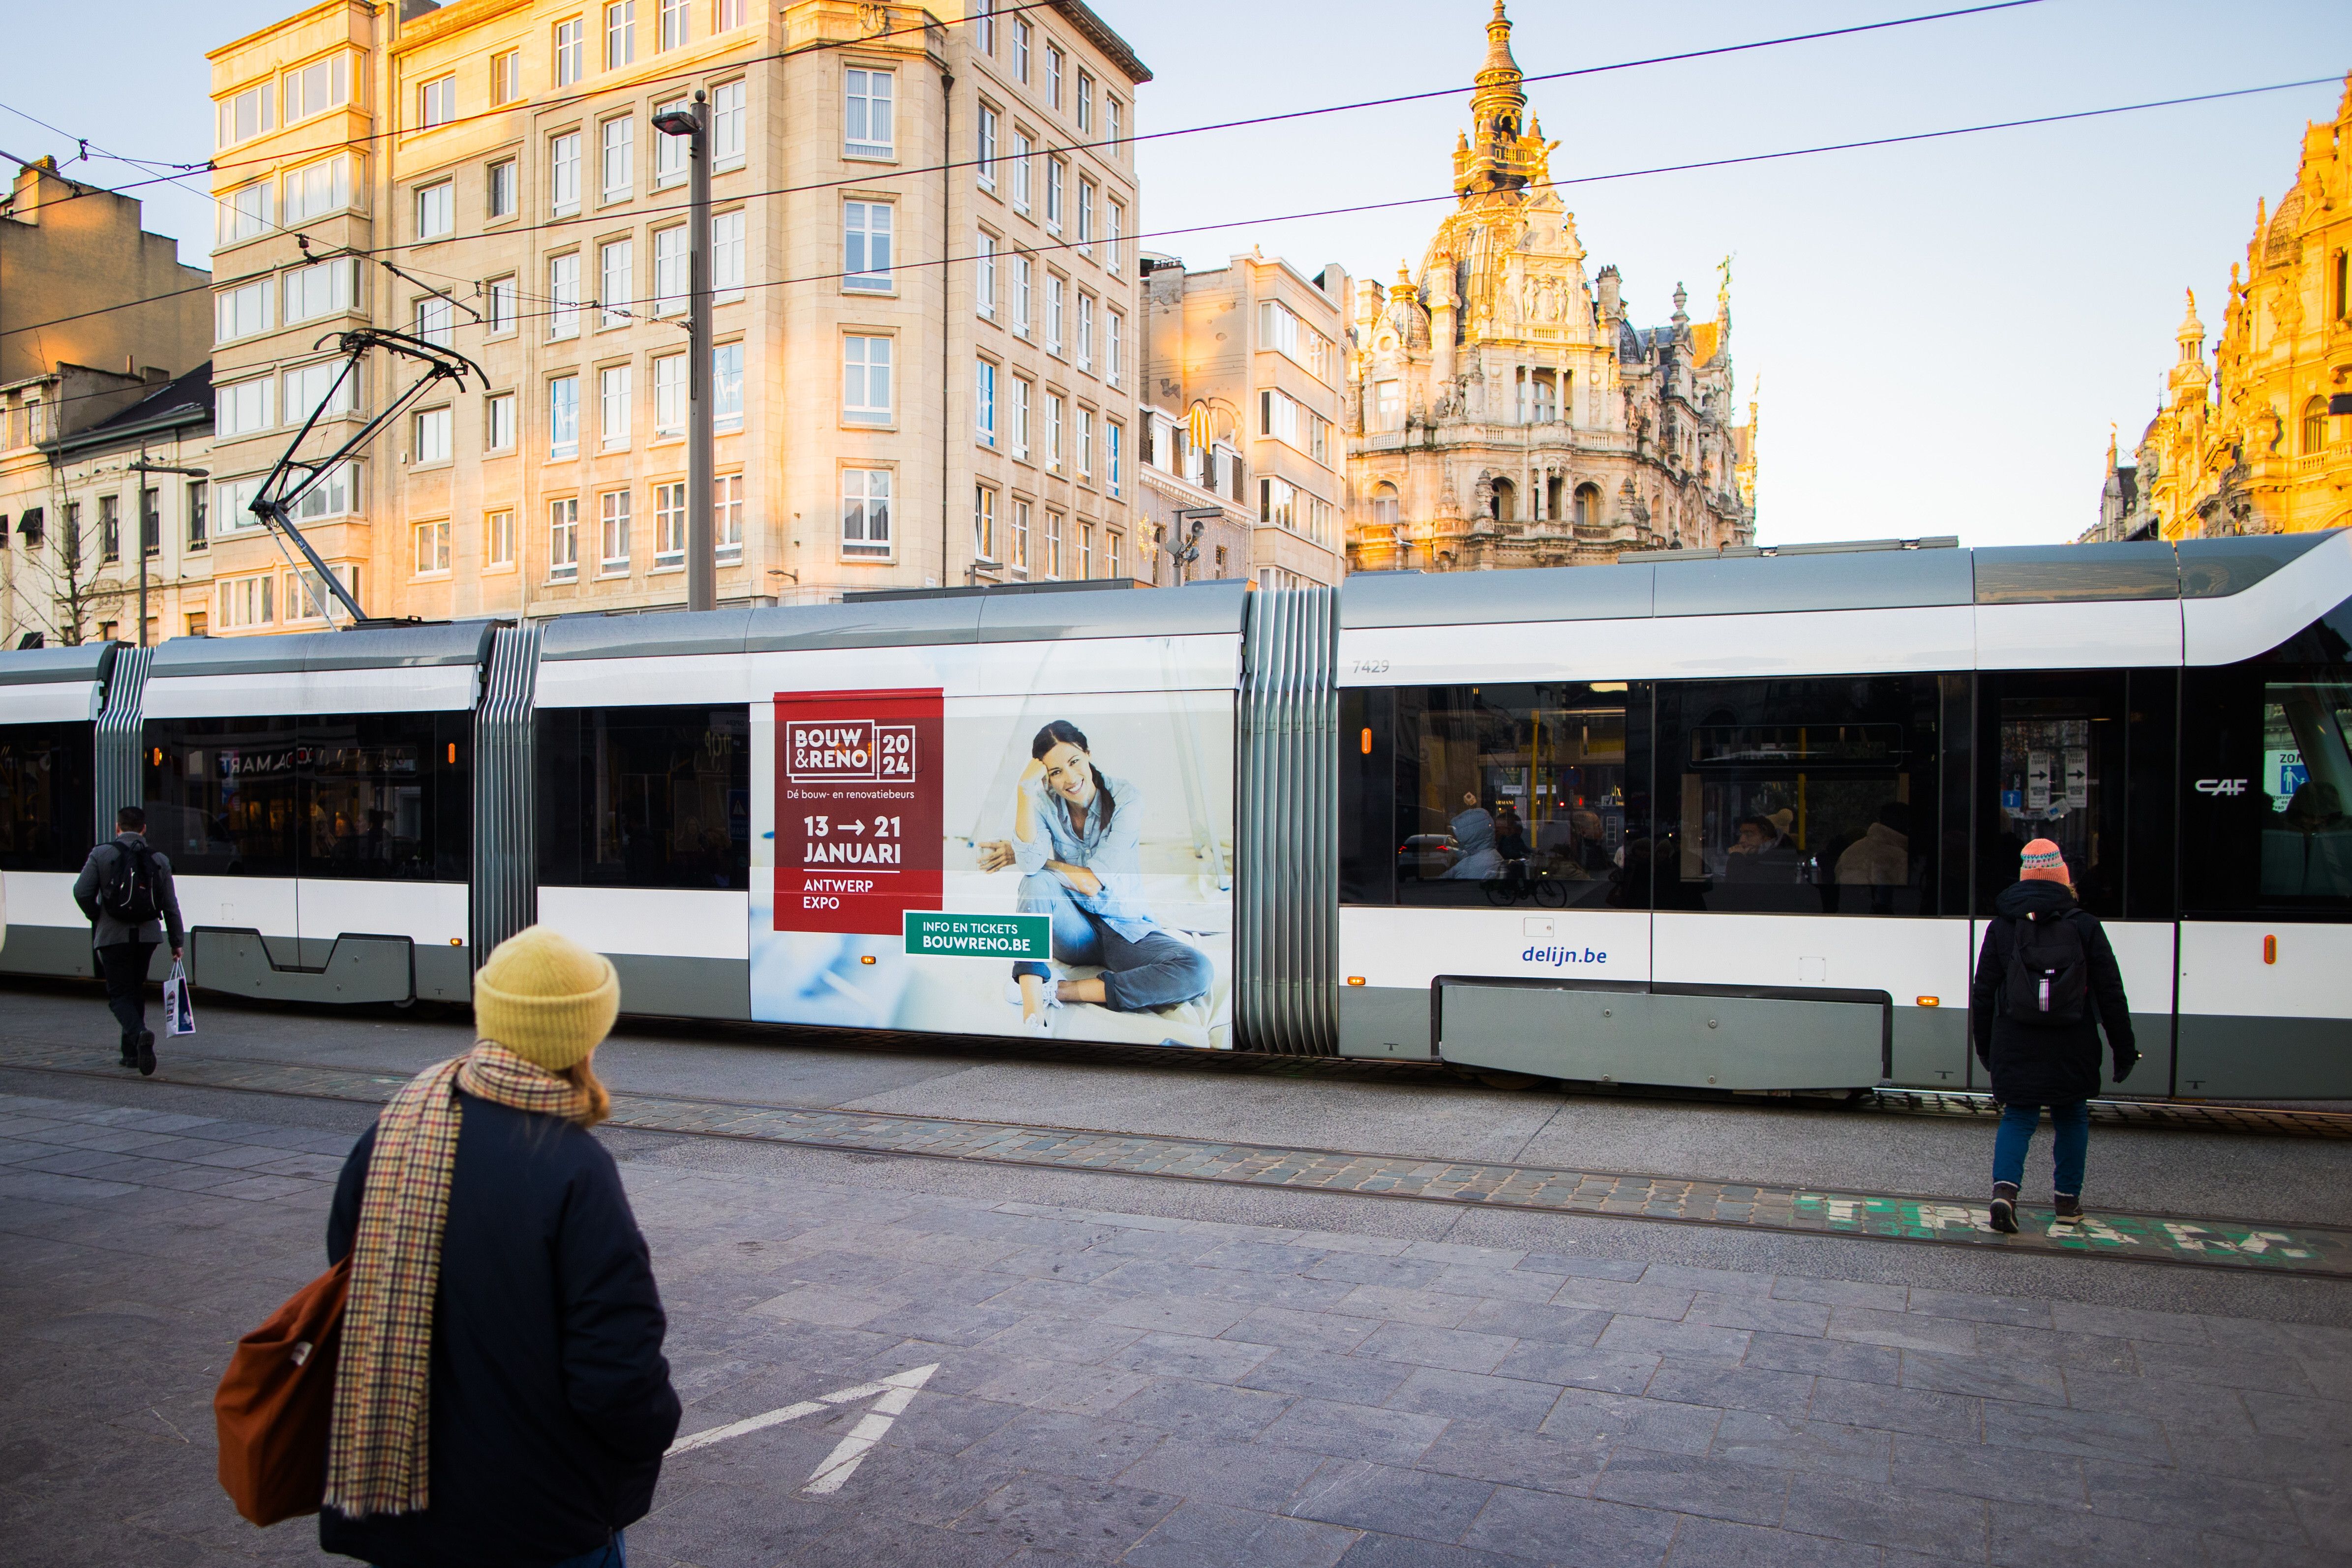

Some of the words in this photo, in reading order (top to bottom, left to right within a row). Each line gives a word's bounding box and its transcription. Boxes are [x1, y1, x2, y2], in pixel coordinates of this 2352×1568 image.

[1353, 660, 1389, 673] 7429
[795, 728, 862, 748] BOUW
[882, 734, 910, 754] 20
[795, 748, 868, 768] &RENO
[882, 755, 910, 775] 24
[787, 789, 799, 799] Dé
[801, 789, 830, 799] bouw-
[846, 789, 915, 799] renovatiebeurs
[2195, 779, 2248, 796] CAF
[804, 815, 829, 837] 13
[874, 815, 900, 837] 21
[804, 843, 901, 864] JANUARI
[804, 879, 874, 893] ANTWERP
[803, 896, 840, 909] EXPO
[923, 921, 950, 932] INFO
[953, 922, 968, 933] EN
[970, 923, 1018, 935] TICKETS
[923, 935, 1031, 951] BOUWRENO.BE
[1522, 946, 1607, 967] delijn.be
